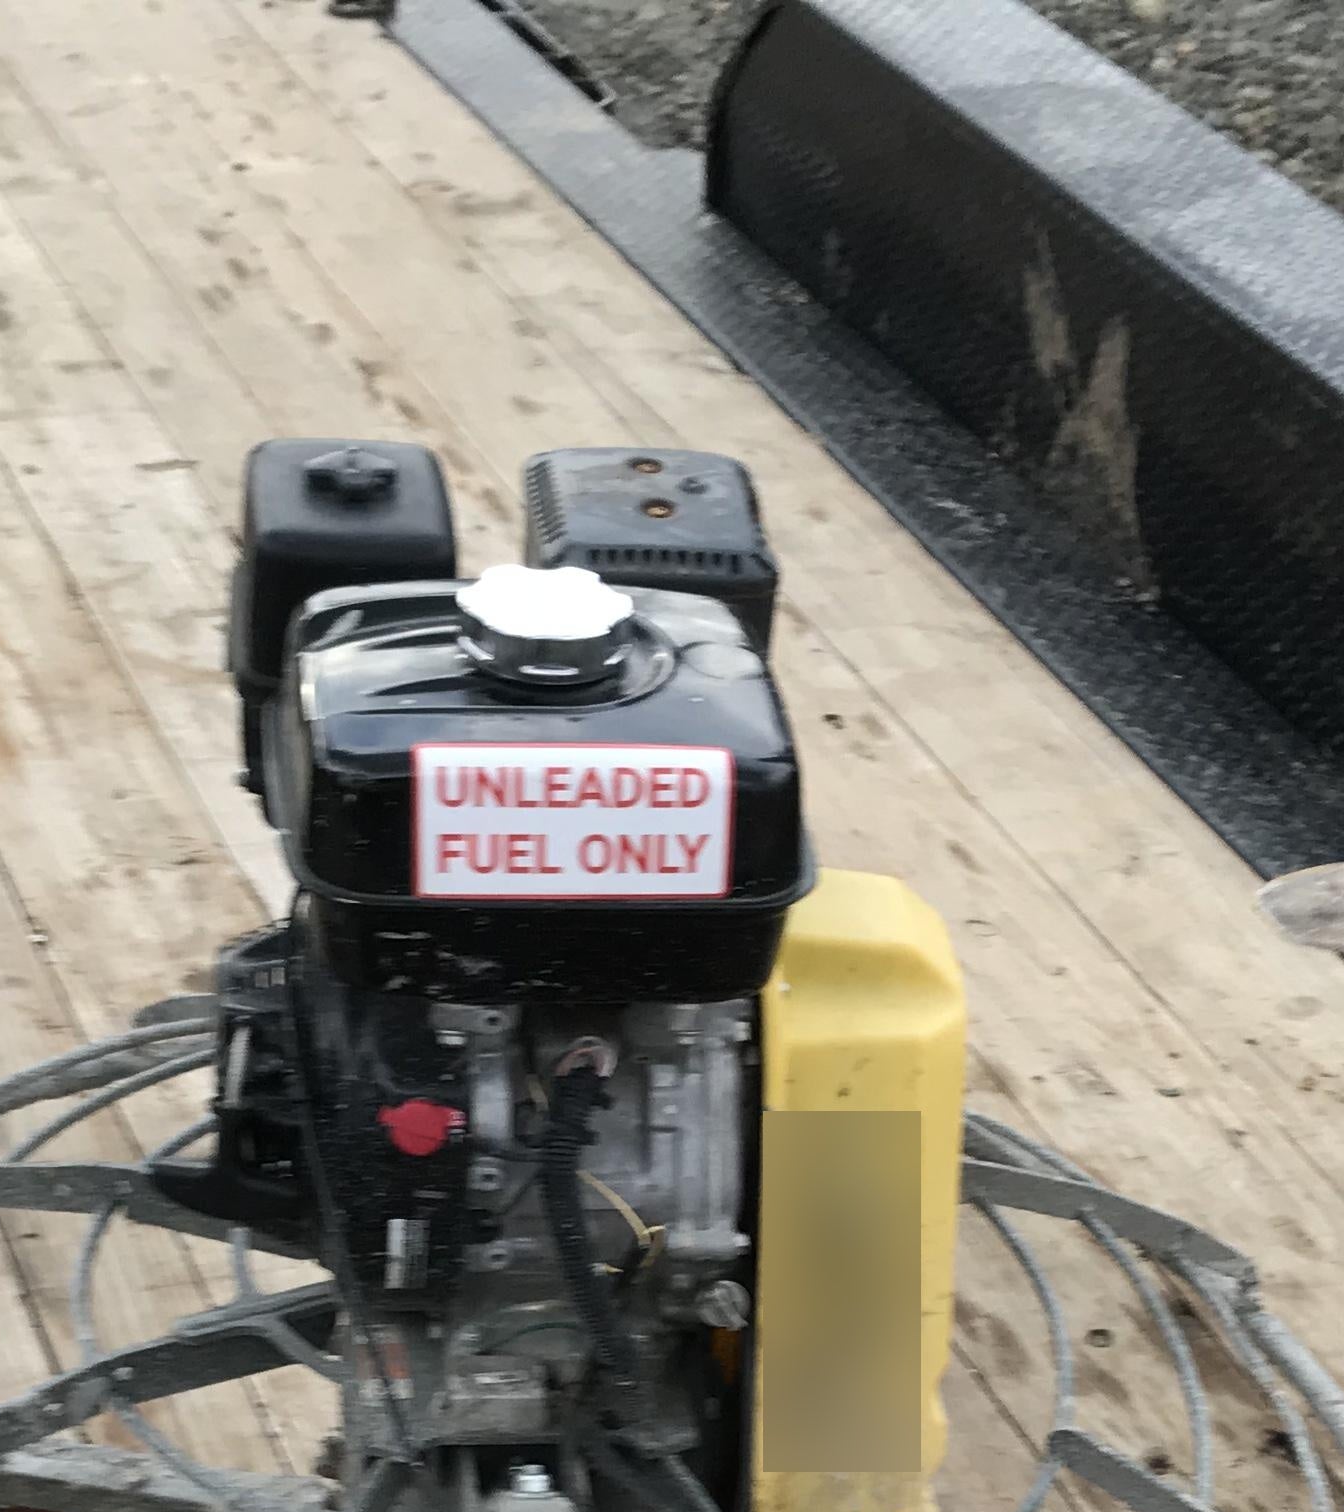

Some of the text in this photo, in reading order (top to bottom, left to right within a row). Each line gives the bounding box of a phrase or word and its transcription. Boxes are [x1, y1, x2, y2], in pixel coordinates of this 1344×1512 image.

[433, 766, 711, 809] UNLEADED
[434, 834, 711, 874] FUEL ONLY
